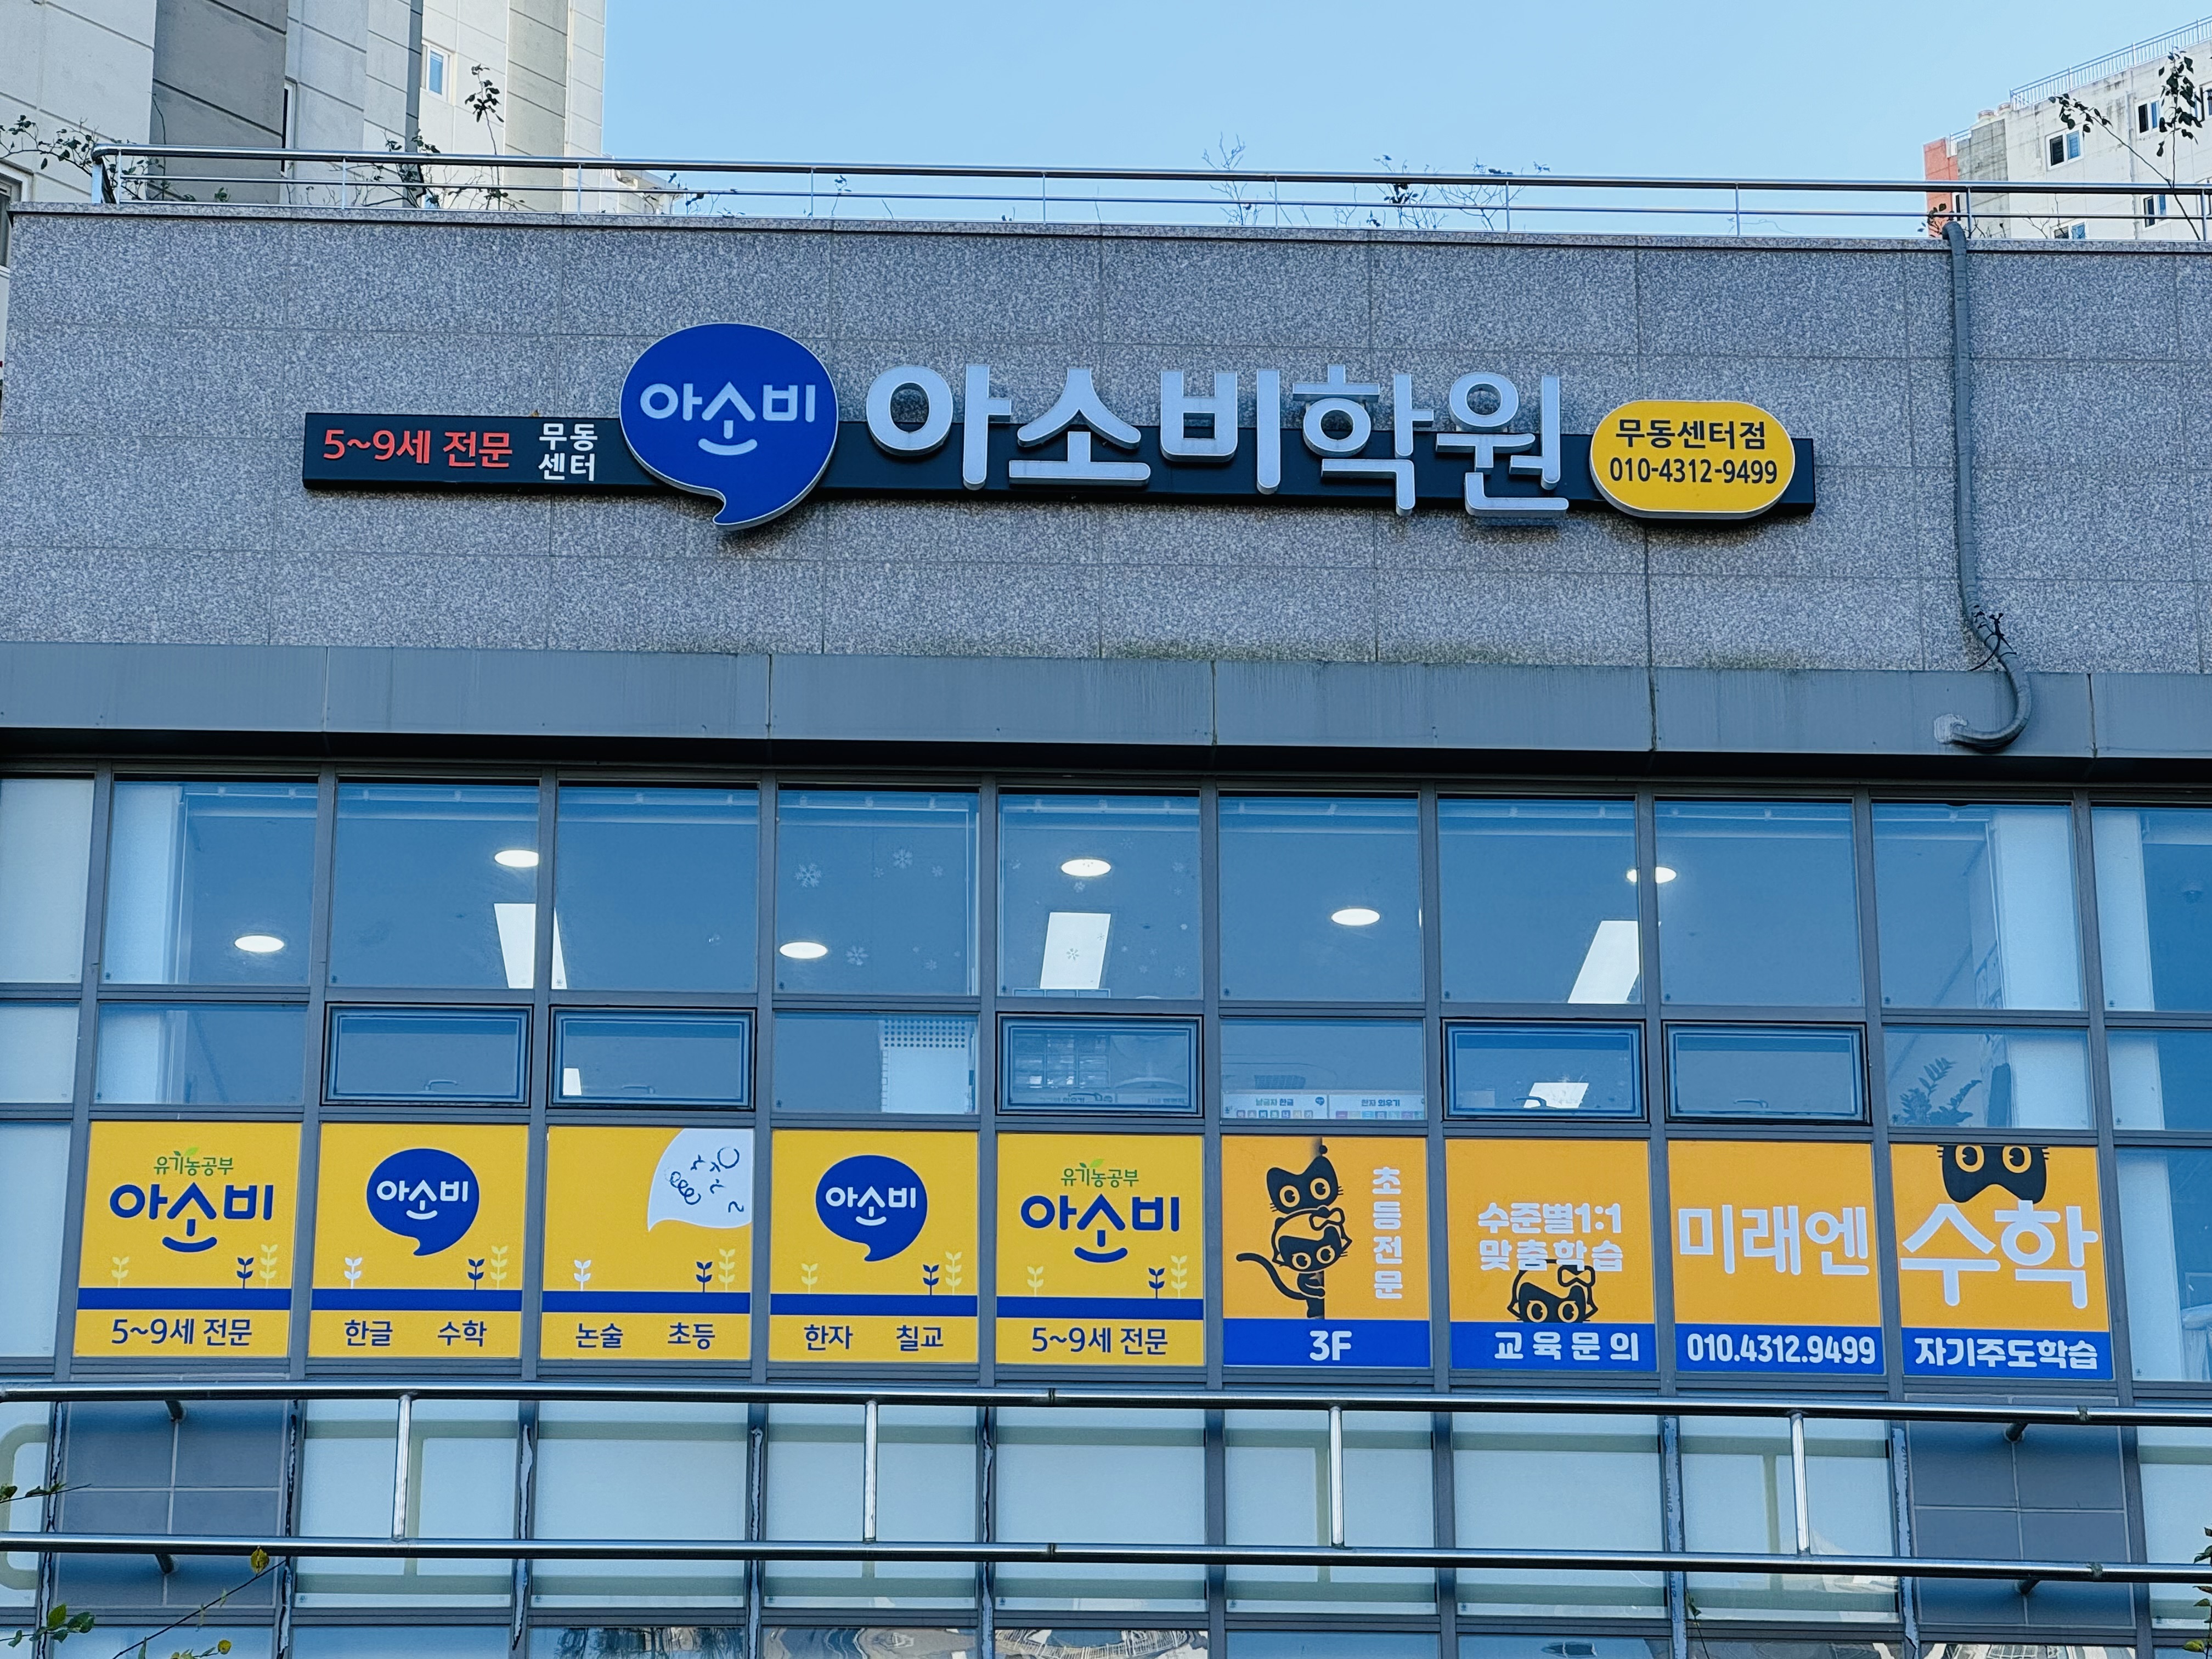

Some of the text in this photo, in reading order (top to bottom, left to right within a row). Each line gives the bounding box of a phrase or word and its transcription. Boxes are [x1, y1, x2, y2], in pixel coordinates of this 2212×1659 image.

[640, 381, 816, 456] 아소비
[323, 430, 513, 467] 5~9세 전문
[539, 423, 598, 452] 무동
[865, 363, 1570, 518] 아소비학원
[1616, 419, 1765, 450] 무동센터점
[538, 453, 595, 482] 센터
[1610, 457, 1778, 484] 010-4312-9499
[153, 1154, 234, 1177] 유기농공부
[1060, 1166, 1139, 1188] 유기농공부
[376, 1180, 470, 1220] 아소비
[825, 1186, 917, 1227] 아소비
[109, 1182, 274, 1253] 아소비
[1020, 1193, 1180, 1263] 아소비
[1372, 1166, 1403, 1299] 초등전문
[1477, 1202, 1622, 1234] 수준별1:1
[1479, 1239, 1623, 1272] 맞춤학습
[1677, 1198, 2101, 1311] 미래엔 수학
[111, 1318, 252, 1346] 5~9세 전문
[345, 1319, 487, 1347] 한글 수학
[575, 1322, 715, 1350] 논술 초등
[804, 1324, 944, 1352] 한자 칠교
[1032, 1327, 1168, 1355] 5~9세 전문
[1310, 1330, 1352, 1361] 3F
[1687, 1333, 1876, 1364] 010.4312.9499
[1914, 1337, 2098, 1370] 자기주도학습
